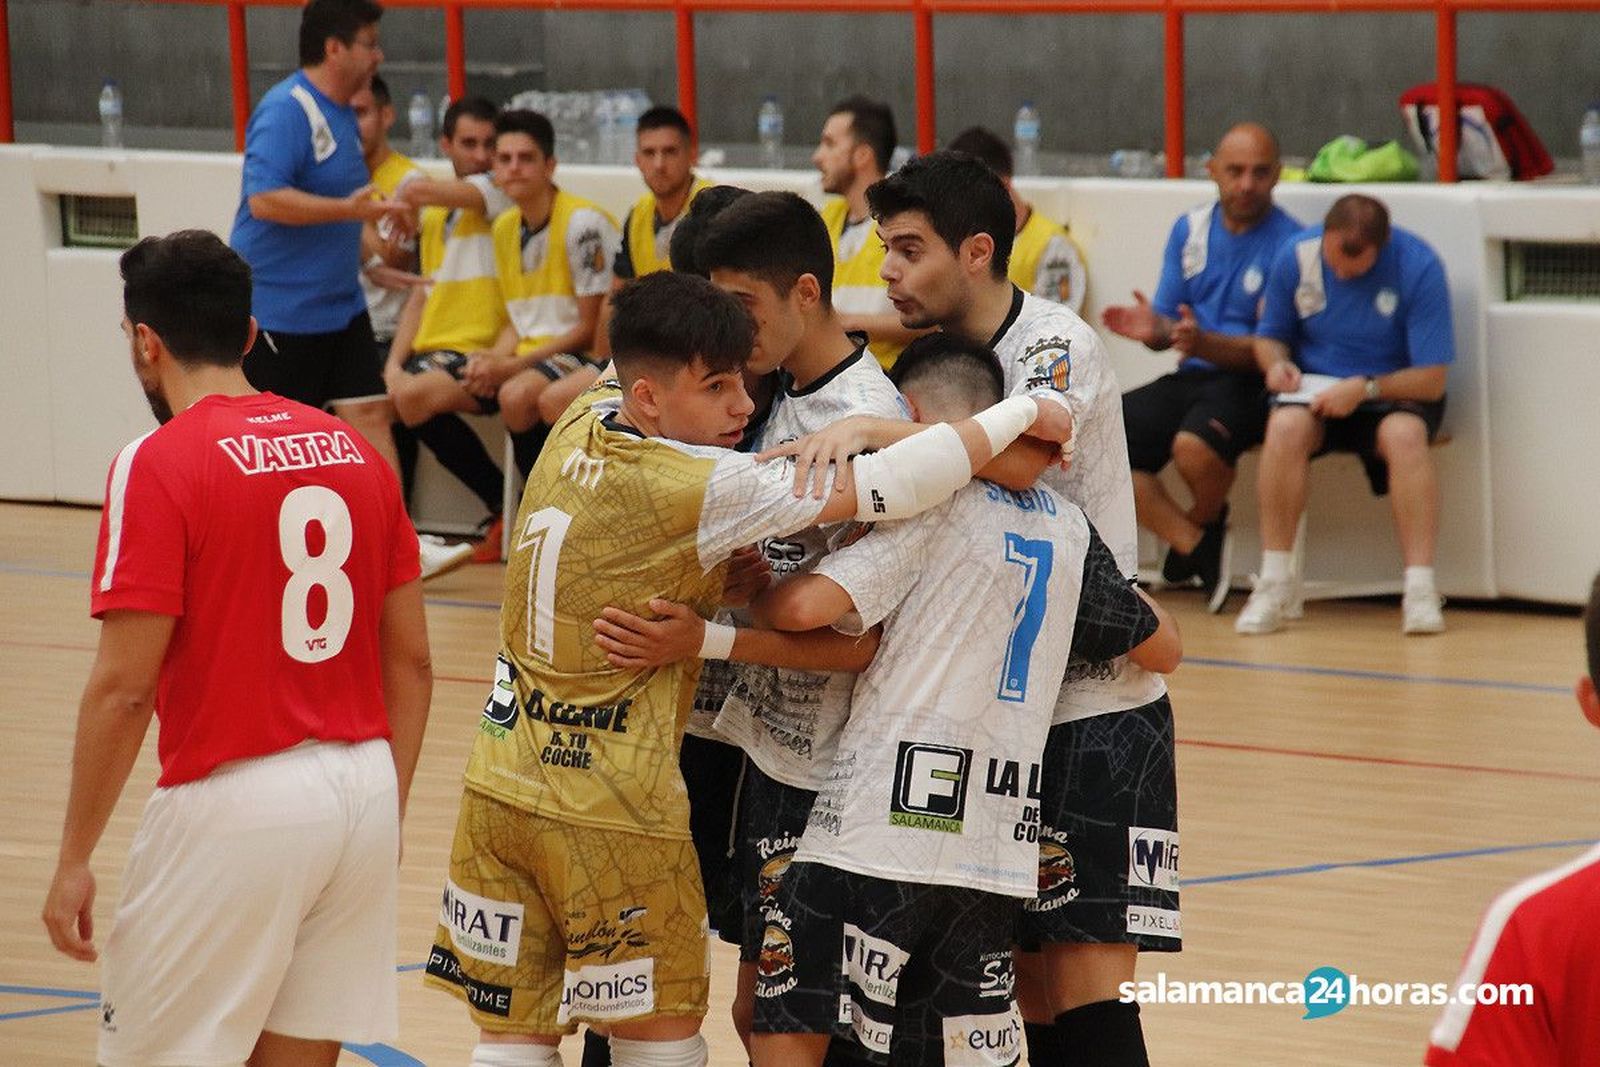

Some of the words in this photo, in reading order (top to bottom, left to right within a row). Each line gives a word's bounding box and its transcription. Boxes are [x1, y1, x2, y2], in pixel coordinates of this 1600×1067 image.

[217, 431, 366, 476] VALTRA
[279, 485, 354, 664] 8
[516, 506, 573, 665] 1
[997, 531, 1054, 703] 7
[541, 746, 592, 770] COCHE
[986, 758, 1020, 798] LA
[891, 814, 963, 833] SALAMANCA
